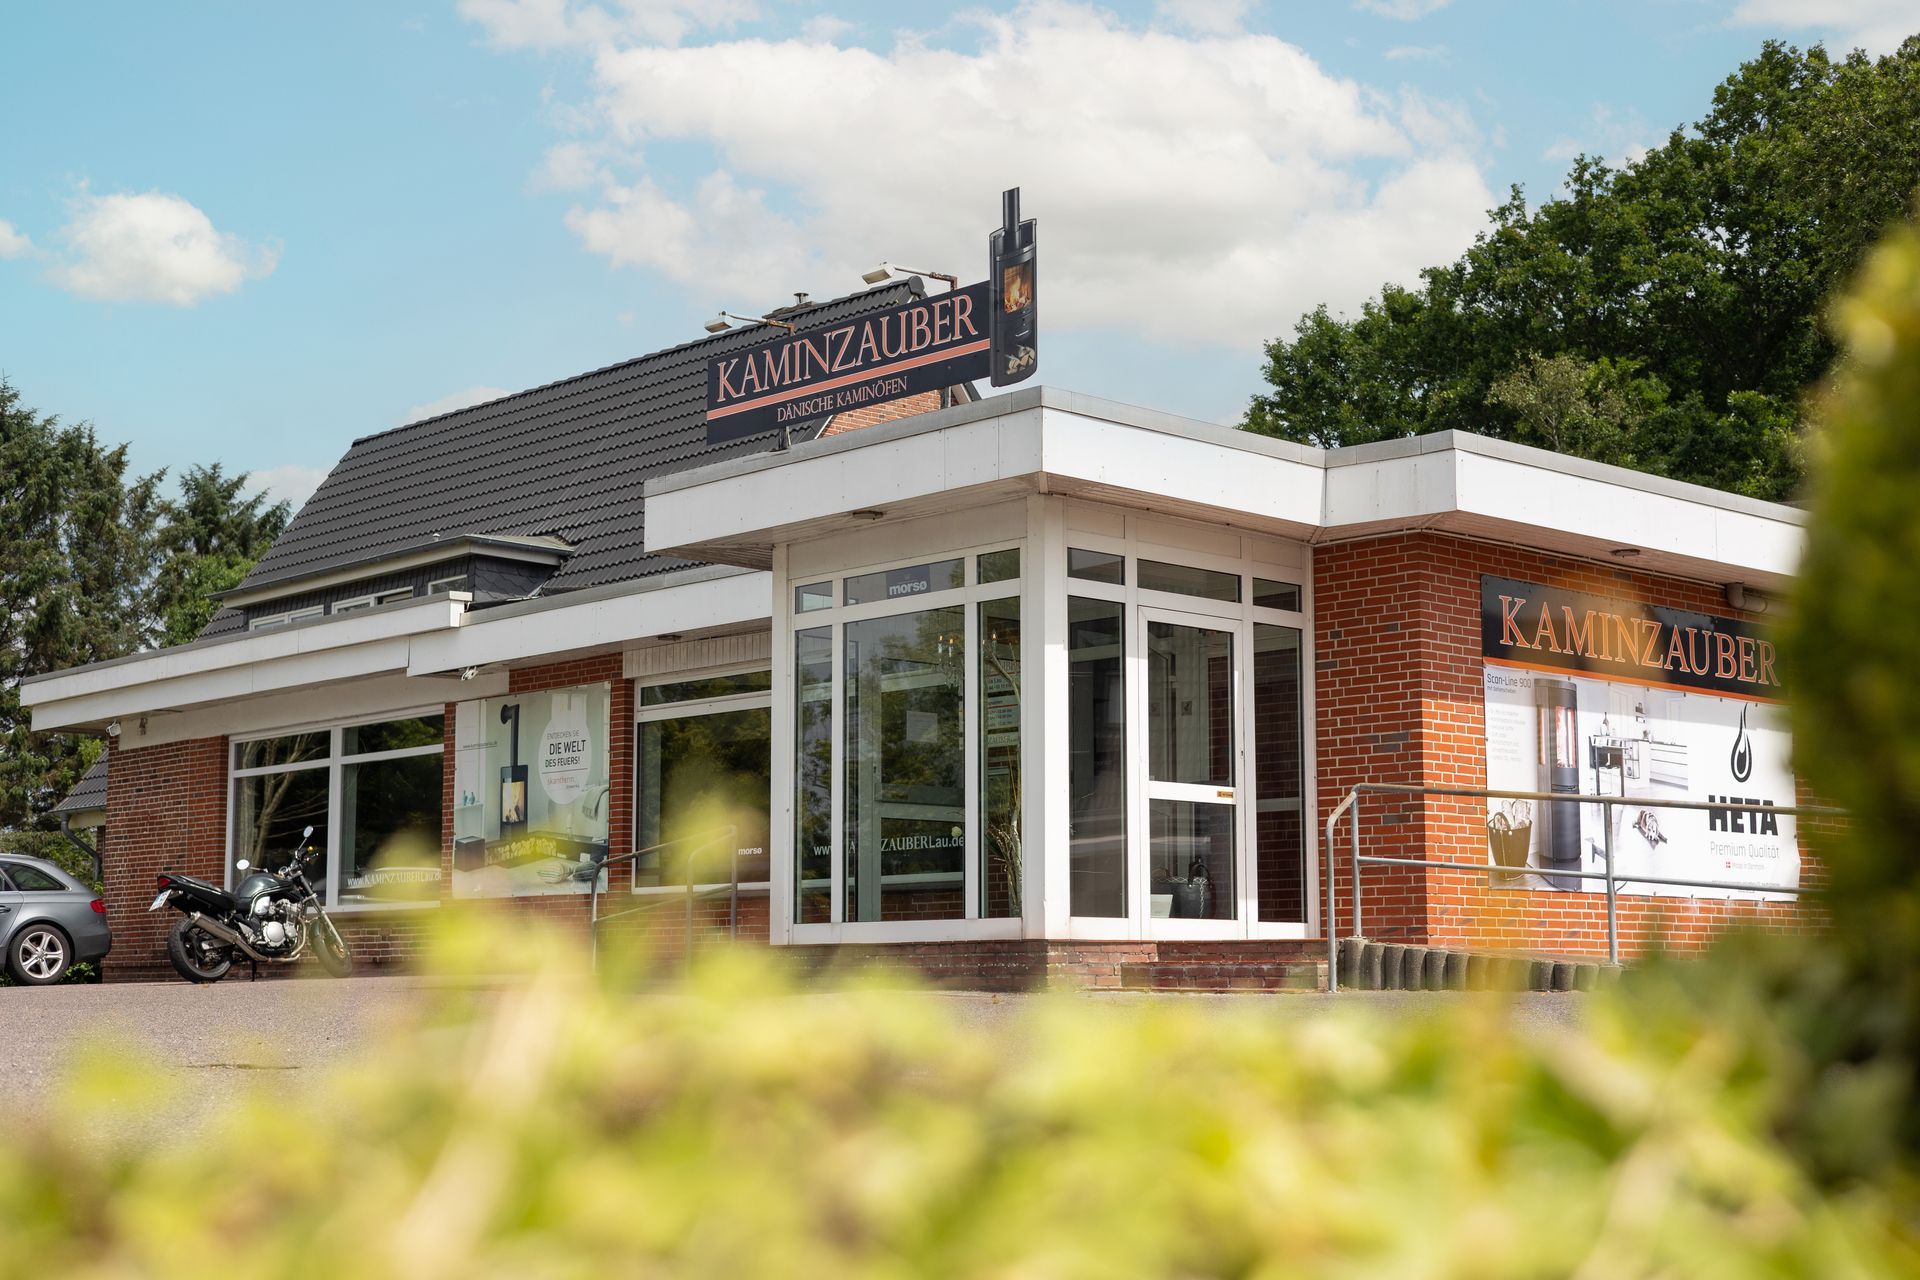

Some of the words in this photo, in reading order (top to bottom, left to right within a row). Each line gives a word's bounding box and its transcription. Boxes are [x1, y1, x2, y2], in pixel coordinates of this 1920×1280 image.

[717, 294, 978, 402] KAMINZAUBER
[777, 394, 834, 422] DÄNISCHE
[836, 376, 908, 408] KAMINÖFEN
[1499, 594, 1781, 687] KAMINZAUBER
[1487, 673, 1517, 687] Scan-Line
[1519, 677, 1532, 689] 900
[545, 758, 556, 768] DES
[557, 756, 580, 767] FEUERS!
[549, 742, 562, 755] DIE
[563, 739, 586, 754] WELT
[1708, 794, 1778, 836] HETA
[1710, 841, 1746, 857] Premium
[1748, 843, 1780, 859] Qualität
